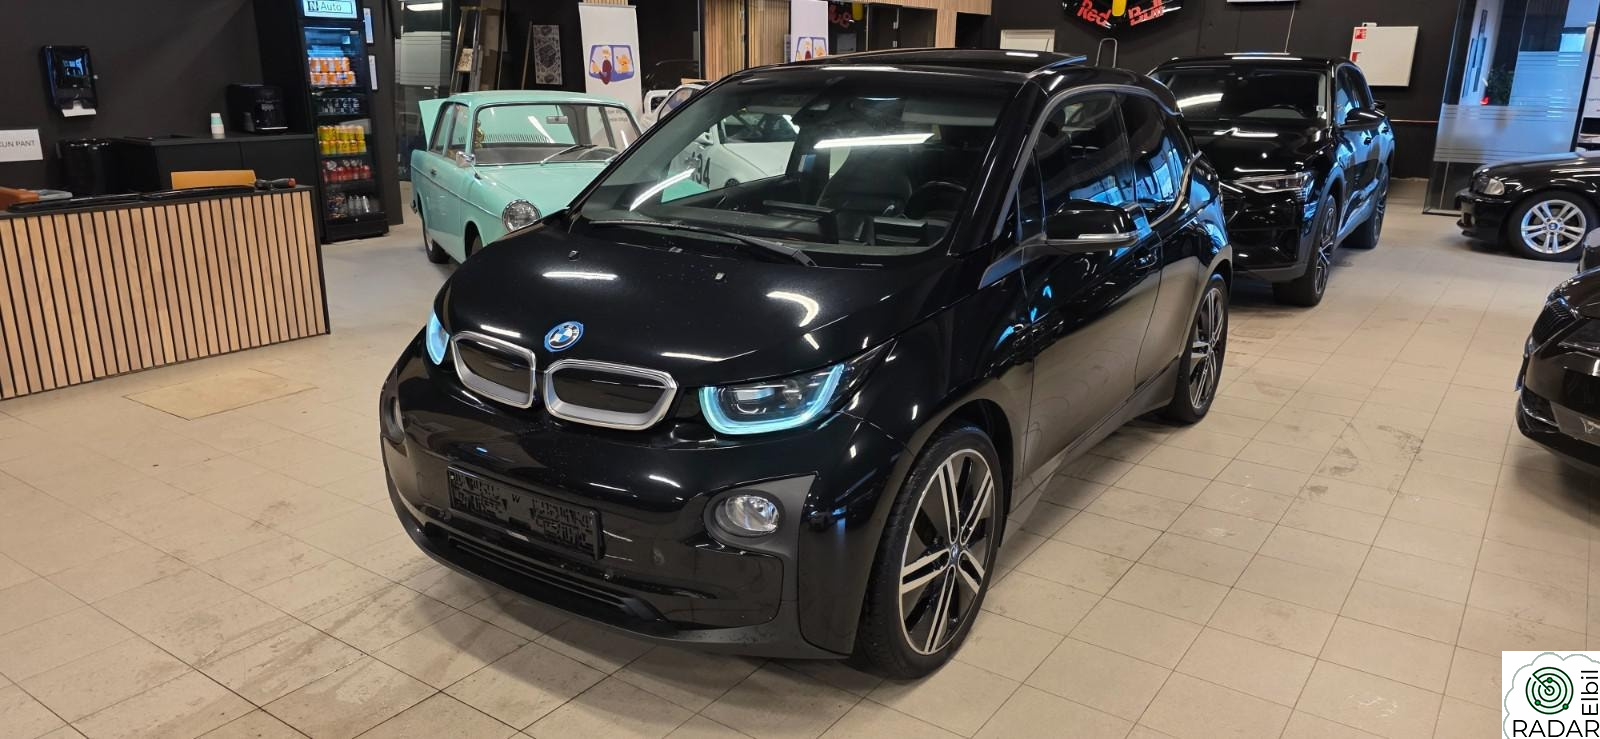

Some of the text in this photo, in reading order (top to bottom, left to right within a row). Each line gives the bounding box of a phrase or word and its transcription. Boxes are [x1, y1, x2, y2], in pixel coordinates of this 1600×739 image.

[320, 1, 342, 11] Auto
[1077, 0, 1165, 27] Red Bull
[15, 139, 35, 147] PANT
